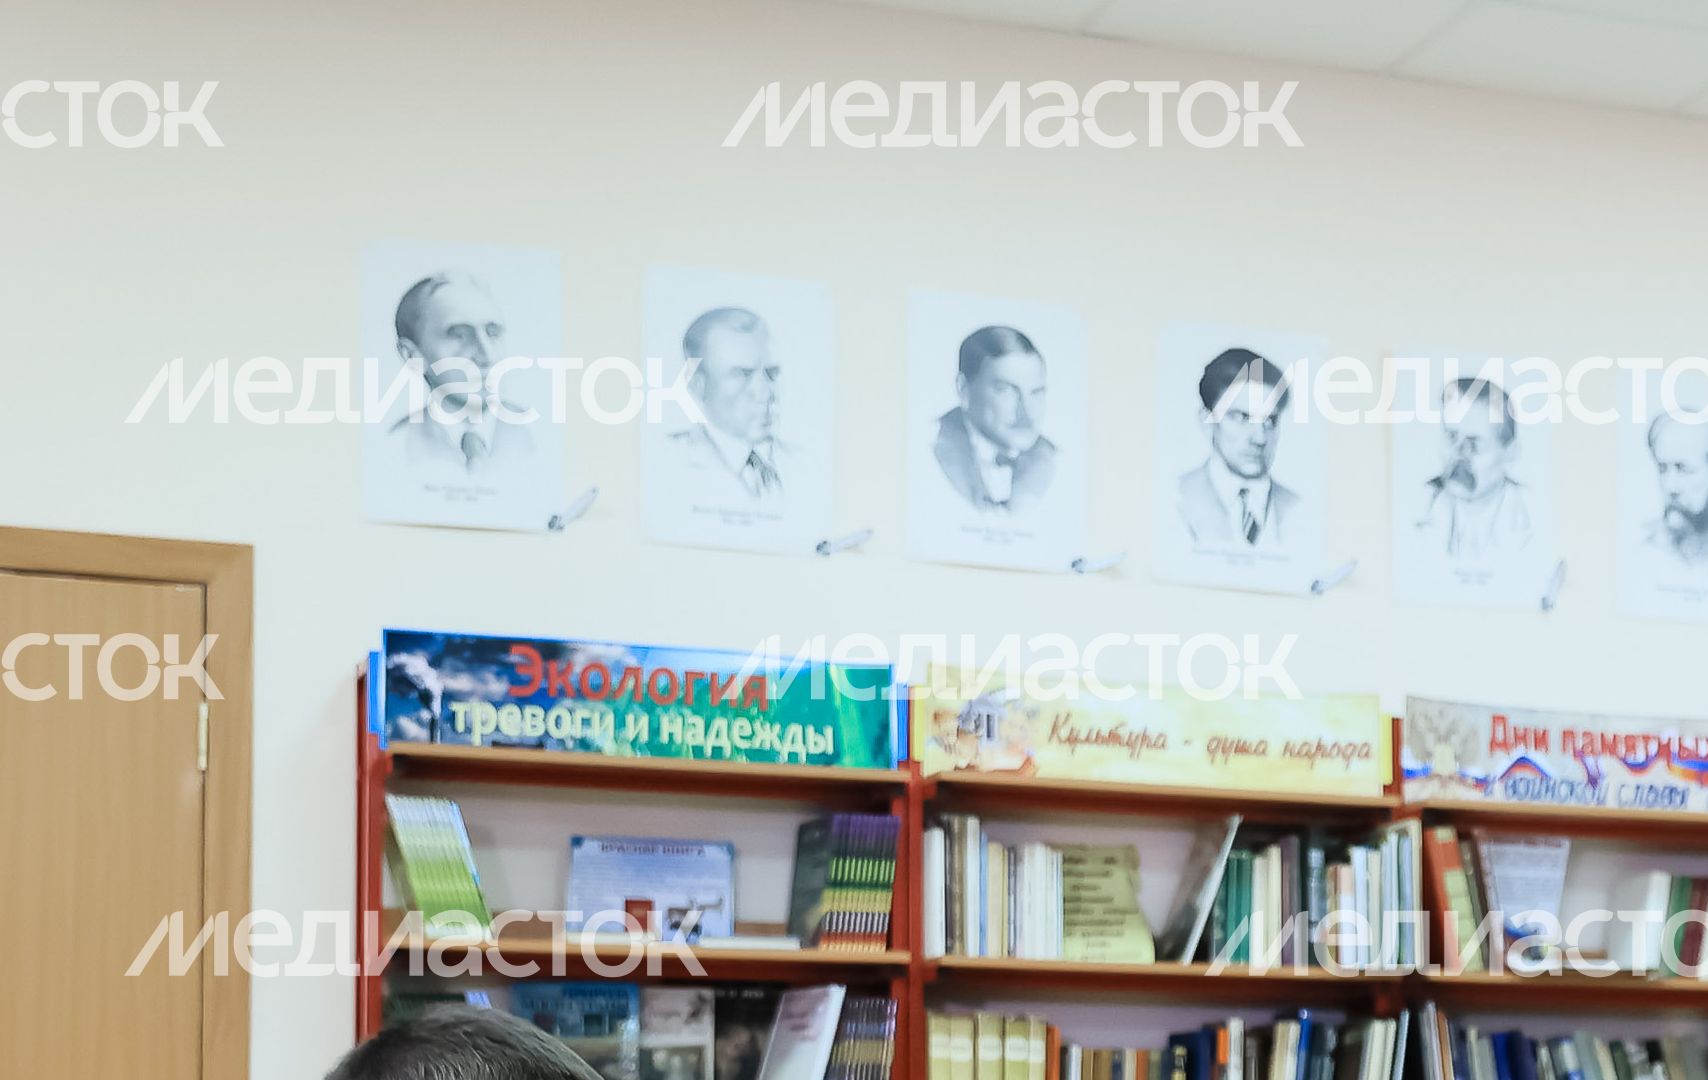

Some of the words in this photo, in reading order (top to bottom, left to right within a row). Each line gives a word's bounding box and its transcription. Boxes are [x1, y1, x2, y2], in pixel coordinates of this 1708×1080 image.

[507, 643, 770, 711] Экология
[450, 701, 614, 747] тревоги
[624, 710, 650, 743] и
[659, 712, 834, 765] надежды
[1048, 712, 1168, 759] Культура
[1206, 735, 1268, 765] душа
[1282, 736, 1373, 770] народа
[1489, 715, 1549, 757] Дни
